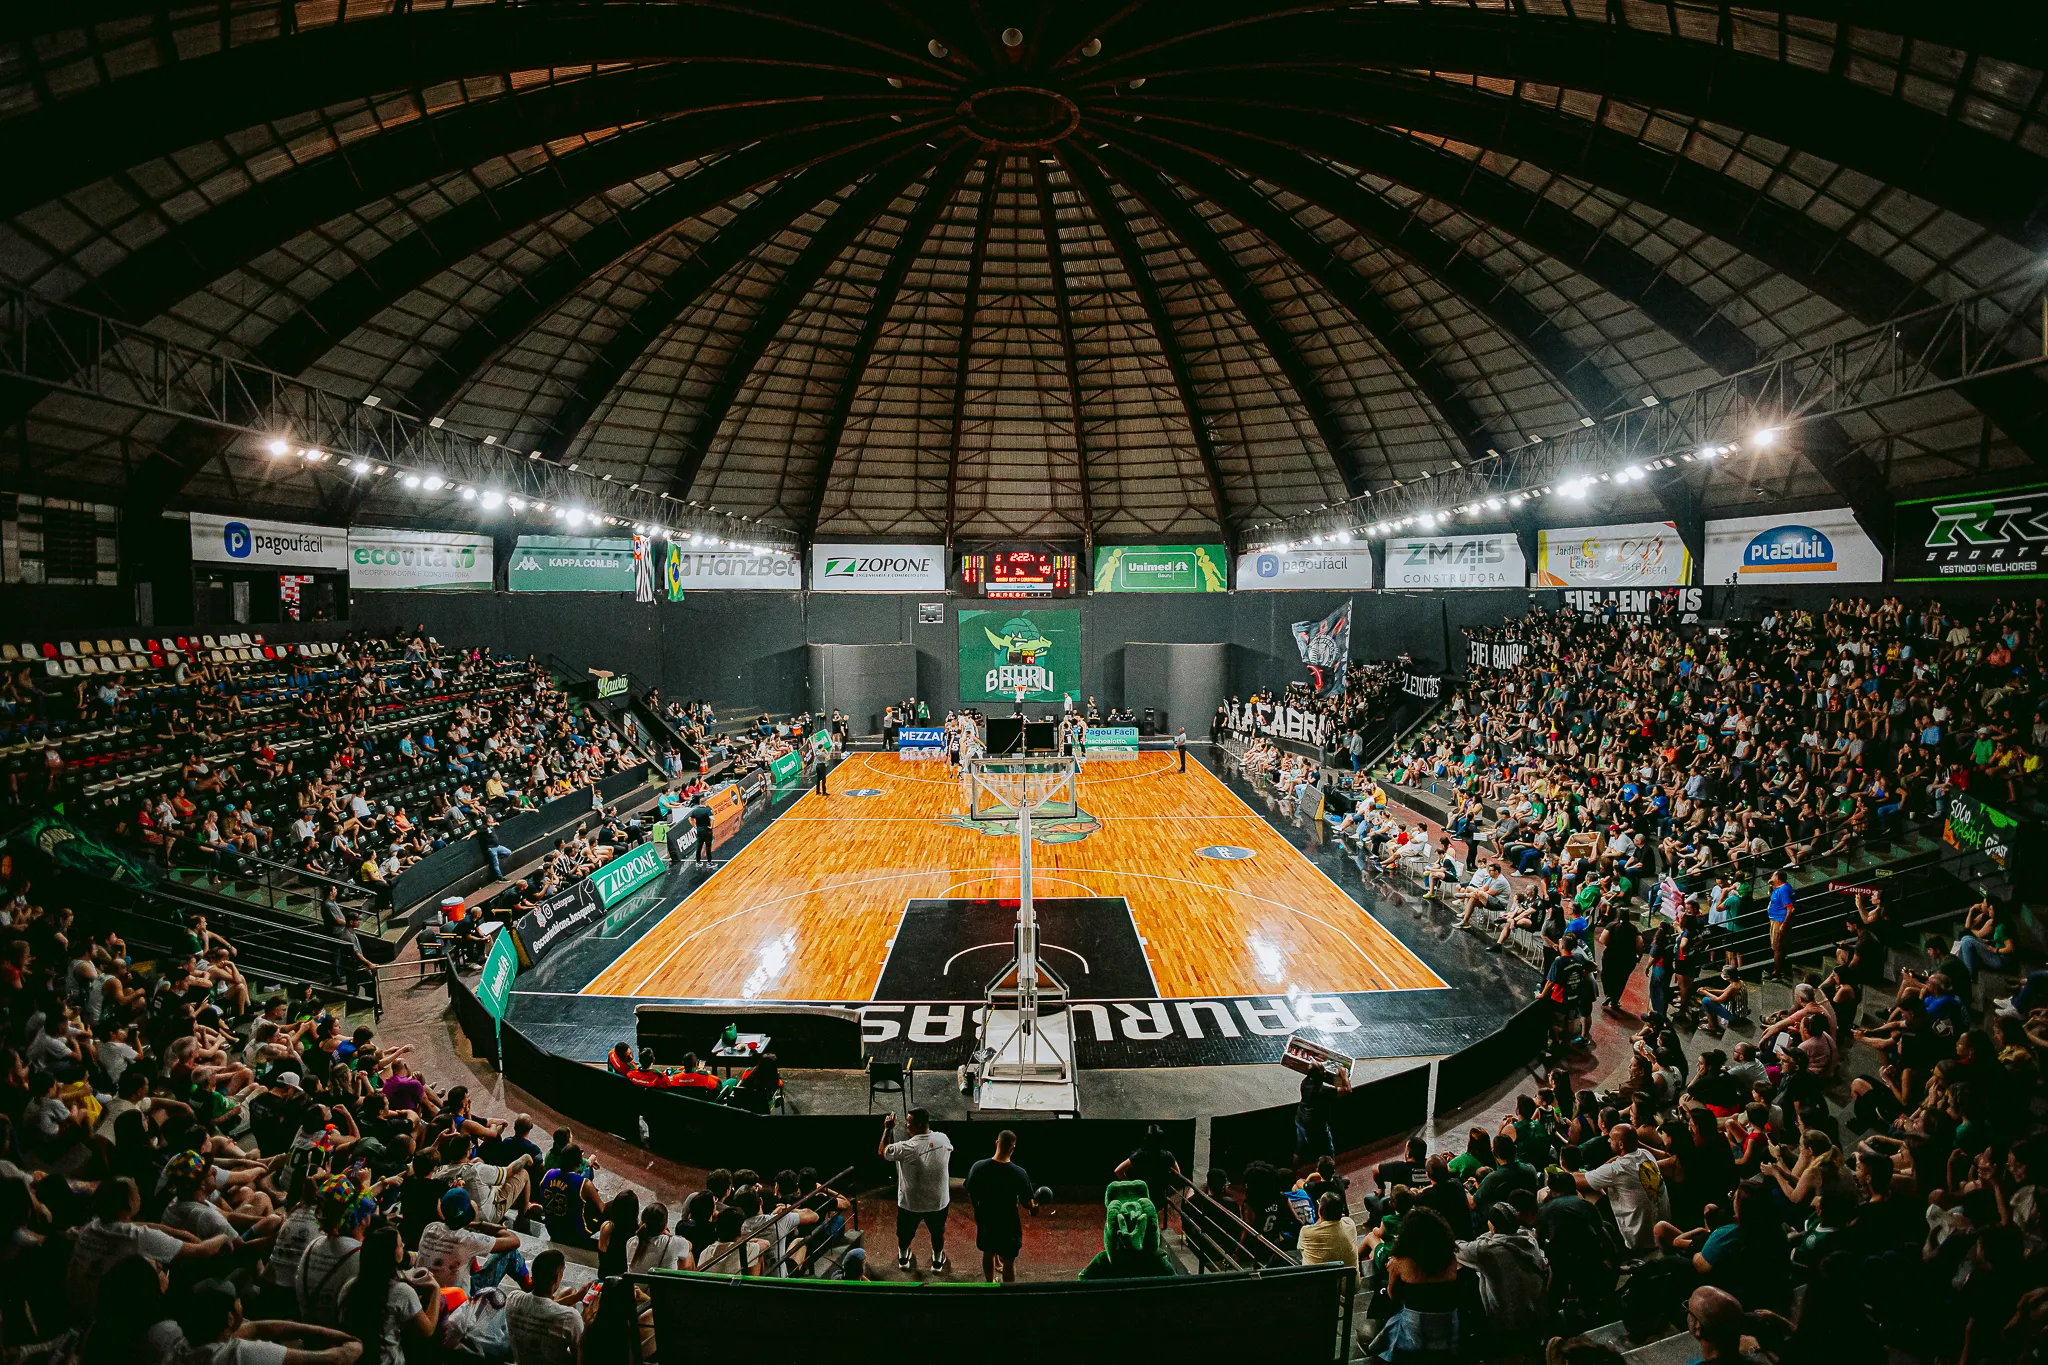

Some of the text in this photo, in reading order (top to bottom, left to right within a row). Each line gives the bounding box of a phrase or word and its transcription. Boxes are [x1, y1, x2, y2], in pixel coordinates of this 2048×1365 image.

[255, 534, 324, 555] pagoufácil
[1555, 544, 1581, 556] Jardim
[354, 547, 448, 568] ecovita
[549, 558, 619, 568] KAPPA.COM.BR
[857, 558, 931, 572] ZOPONE
[1282, 556, 1348, 573] pagoufácil
[1569, 558, 1600, 569] Letras
[358, 569, 416, 577] INCORPORADORA
[696, 555, 796, 577] HanzBet
[1129, 562, 1172, 571] Unimed
[1940, 564, 1977, 574] VESTINDO
[1986, 561, 2037, 572] MELHORES
[1404, 573, 1505, 583] CONSTRUTORA
[598, 675, 629, 698] Bauru
[986, 666, 1054, 693] BAURU
[612, 850, 657, 887] ZOPONE
[551, 894, 576, 911] instagram
